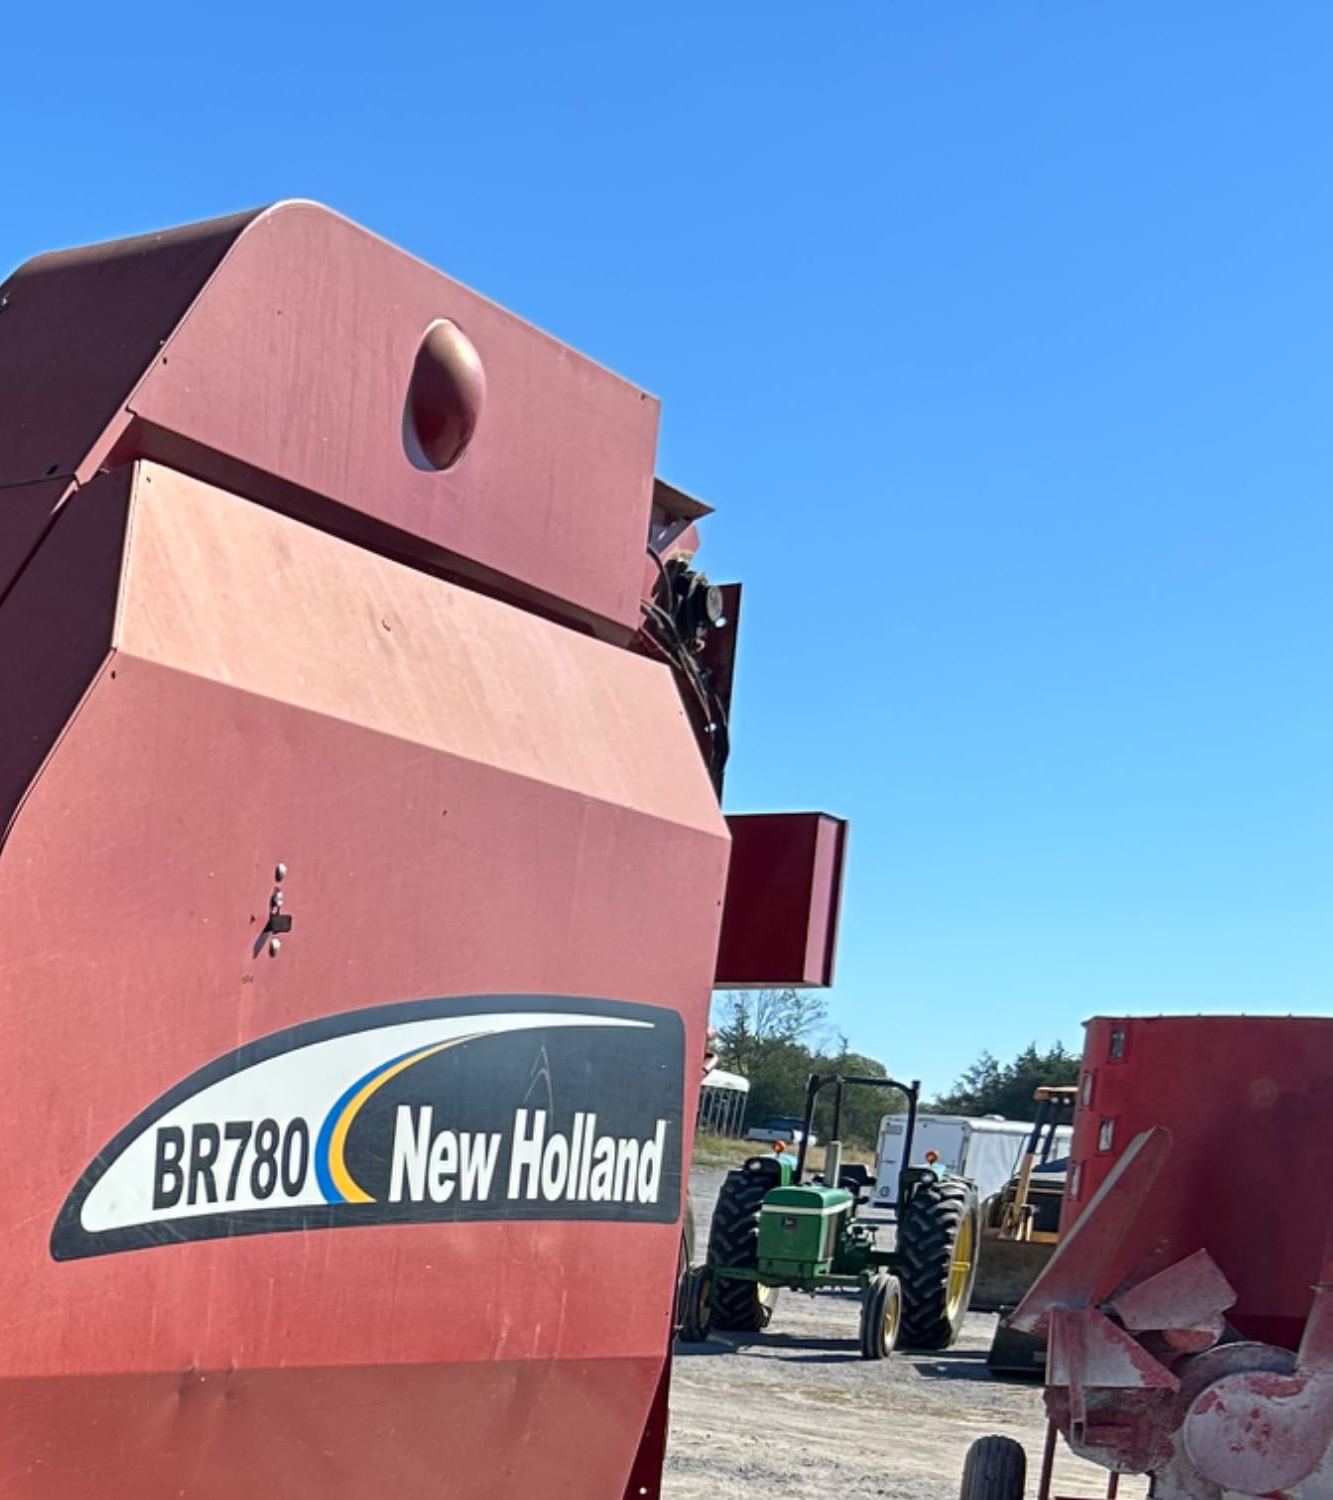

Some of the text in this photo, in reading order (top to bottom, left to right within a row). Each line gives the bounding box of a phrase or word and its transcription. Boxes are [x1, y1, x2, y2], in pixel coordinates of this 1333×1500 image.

[152, 1104, 668, 1209] BR780 New Holland
